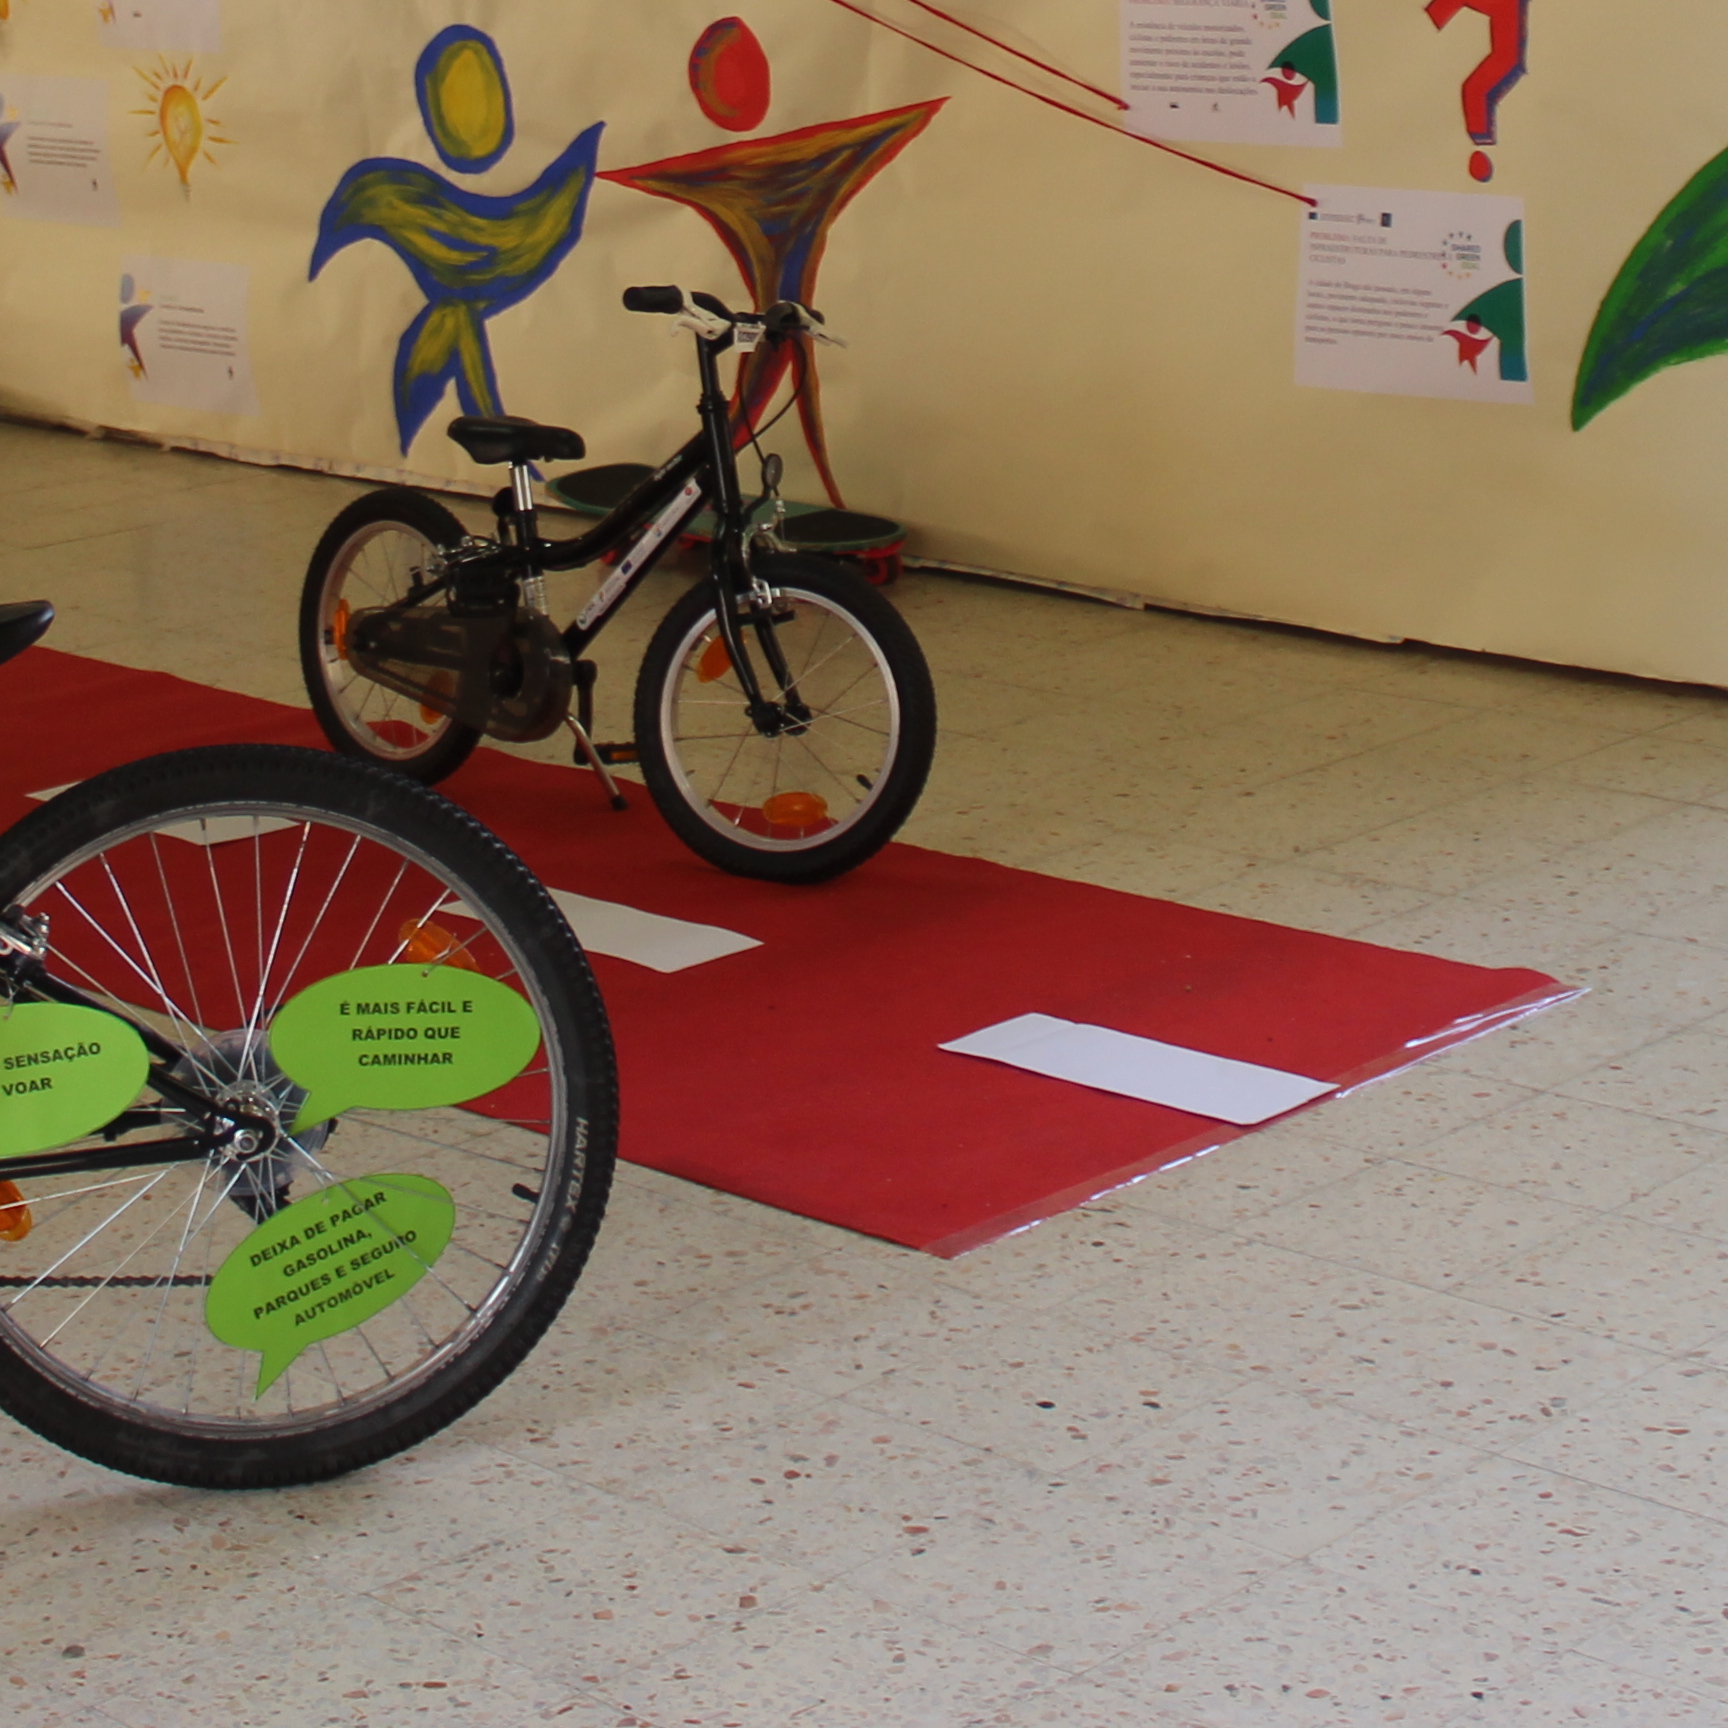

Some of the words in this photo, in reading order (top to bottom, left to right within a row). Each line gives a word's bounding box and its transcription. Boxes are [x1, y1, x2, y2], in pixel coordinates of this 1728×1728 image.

[339, 1001, 351, 1016] É
[356, 1001, 401, 1015] MAIS
[406, 999, 457, 1014] FÁCIL
[462, 1000, 473, 1013] E
[351, 1027, 419, 1041] RÁPIDO
[423, 1026, 461, 1040] QUE
[3, 1042, 101, 1071] SENSAÇÃO
[358, 1051, 453, 1067] CAMINHAR
[1, 1077, 53, 1097] VOAR
[565, 1117, 589, 1214] HARTEX
[249, 1235, 301, 1267] DEIXA
[303, 1221, 327, 1240] DE
[329, 1191, 387, 1227] PAGAR
[283, 1229, 372, 1277] GASOLINA,
[253, 1273, 332, 1319] PARQUES
[334, 1265, 347, 1279] E
[349, 1229, 417, 1271] SEGURO
[295, 1269, 395, 1326] AUTOMÓVEL
